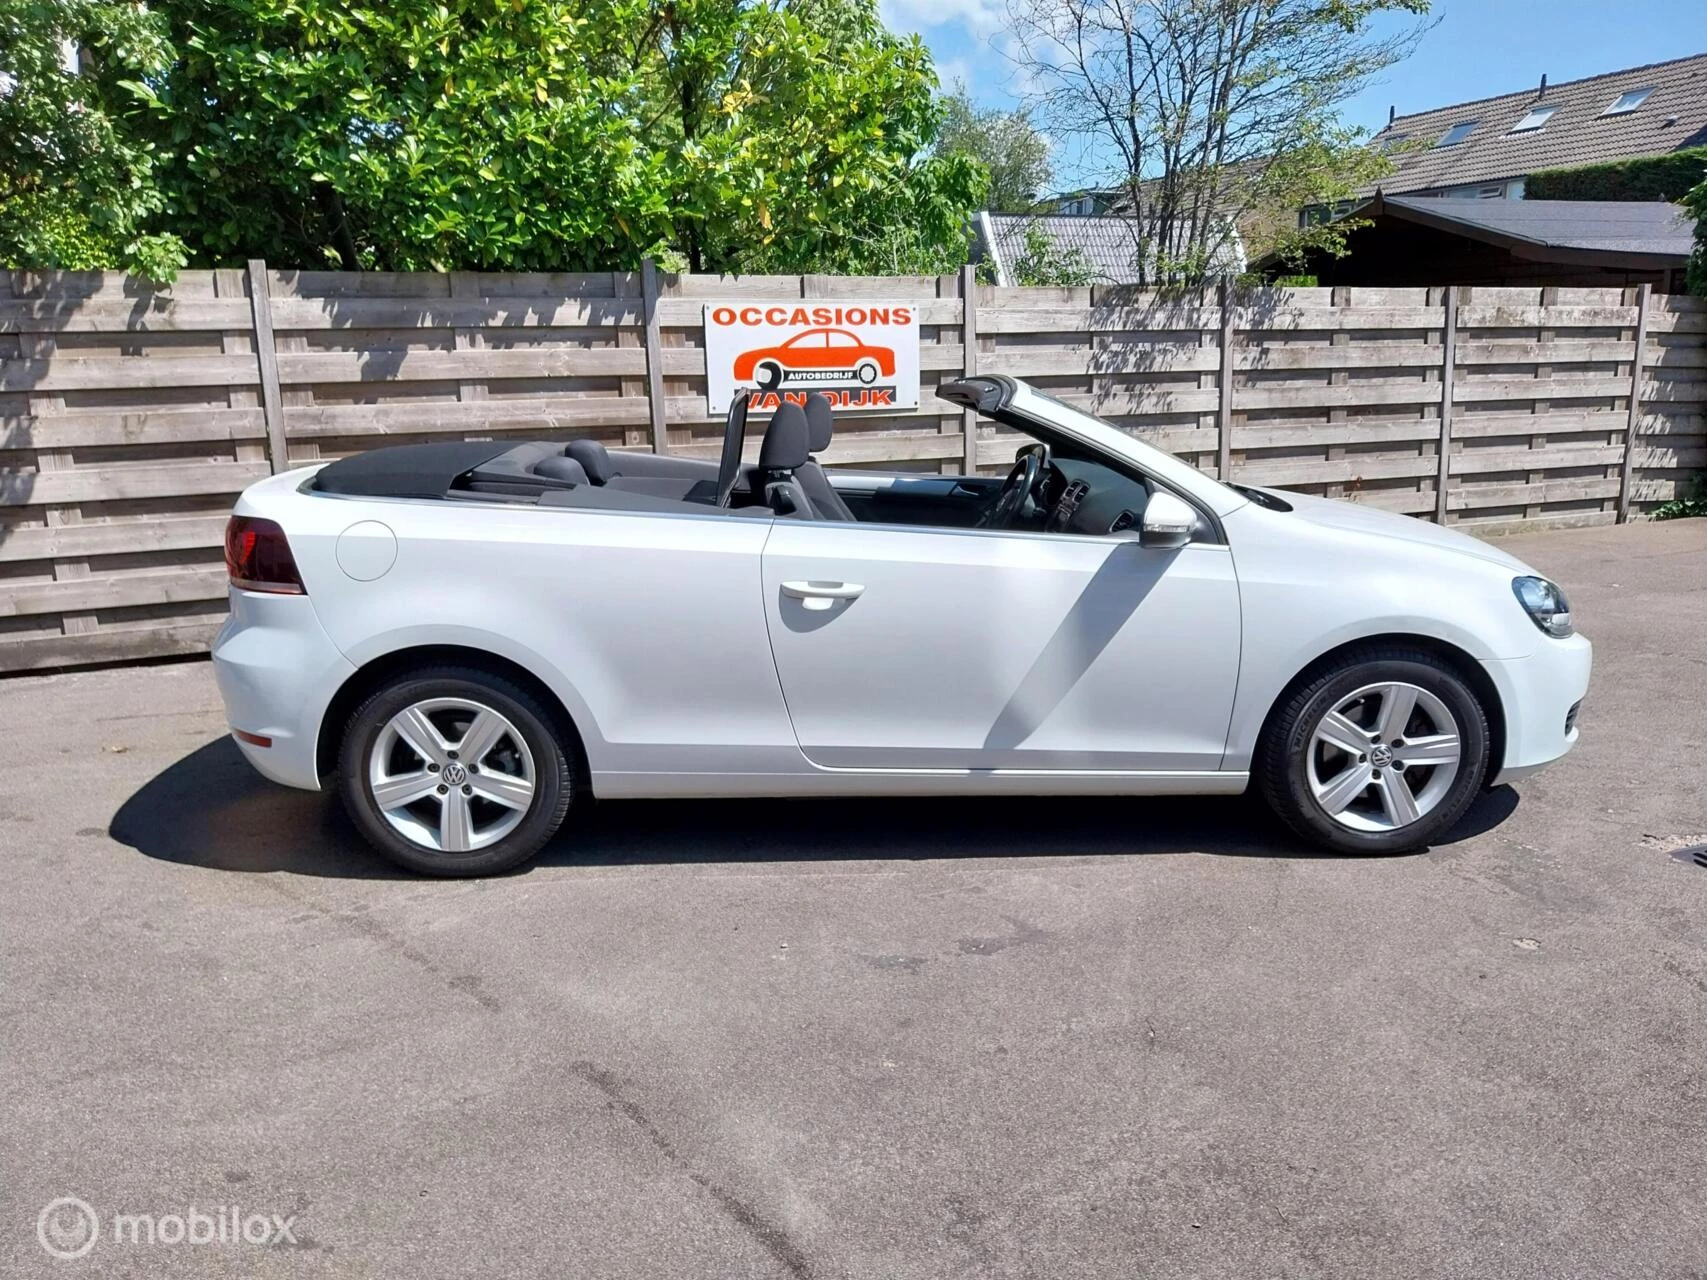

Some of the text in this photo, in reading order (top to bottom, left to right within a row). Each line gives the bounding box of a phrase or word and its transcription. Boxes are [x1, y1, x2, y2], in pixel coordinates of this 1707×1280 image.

[712, 307, 911, 326] OCCASIONS
[788, 371, 853, 381] AUTOBEDRIJF
[819, 389, 893, 407] DIJK
[443, 764, 465, 785] VW
